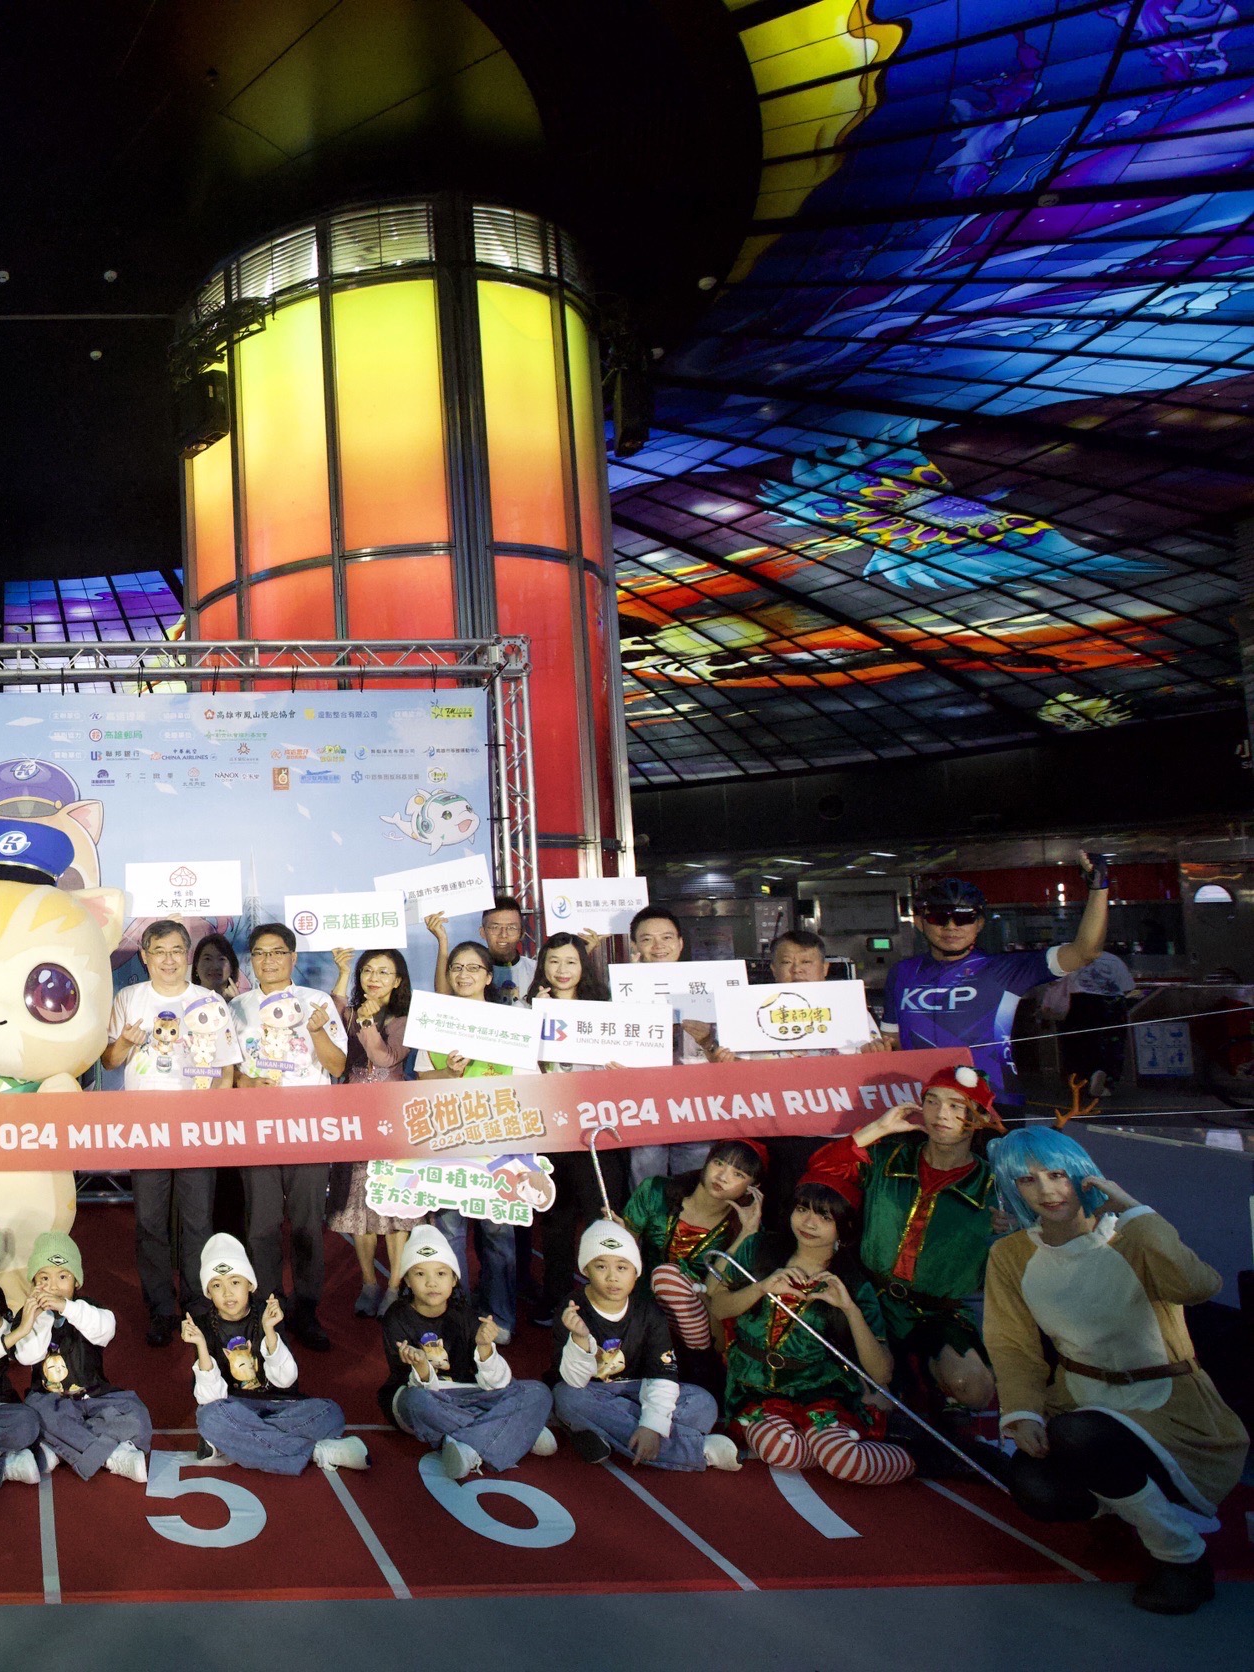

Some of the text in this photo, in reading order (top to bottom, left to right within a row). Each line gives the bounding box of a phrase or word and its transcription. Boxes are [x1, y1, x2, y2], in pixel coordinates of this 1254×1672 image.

[216, 710, 296, 719] 高雄市鳳山慢跑協會
[104, 730, 143, 740] 高雄郵局
[408, 876, 484, 899] 高雄市苓雅運動中心
[576, 899, 643, 908] 舞動陽光有限公司
[323, 912, 399, 931] 高雄郵局
[900, 986, 978, 1011] KCP
[434, 1019, 532, 1043] 創世社會福利基金會
[576, 1020, 665, 1040] 聯邦銀行
[576, 1037, 599, 1045] UNION
[600, 1038, 621, 1046] BANK
[183, 1067, 222, 1077] MIKAN-RUN
[257, 1060, 294, 1071] MIKAN-RUN
[405, 1088, 519, 1142] 蜜柑站長
[577, 1098, 660, 1130] 2024
[666, 1092, 775, 1124] MIKAN
[785, 1086, 852, 1116] RUN
[68, 1122, 176, 1150] MIKAN
[182, 1120, 246, 1147] RUN
[256, 1116, 363, 1144] FINISH
[431, 1110, 544, 1149] 2024 耶誕路跑
[371, 1160, 512, 1192] 救一個植物人
[369, 1181, 531, 1223] 等於救一個家庭
[145, 1449, 268, 1548] 5
[417, 1451, 576, 1549] 6
